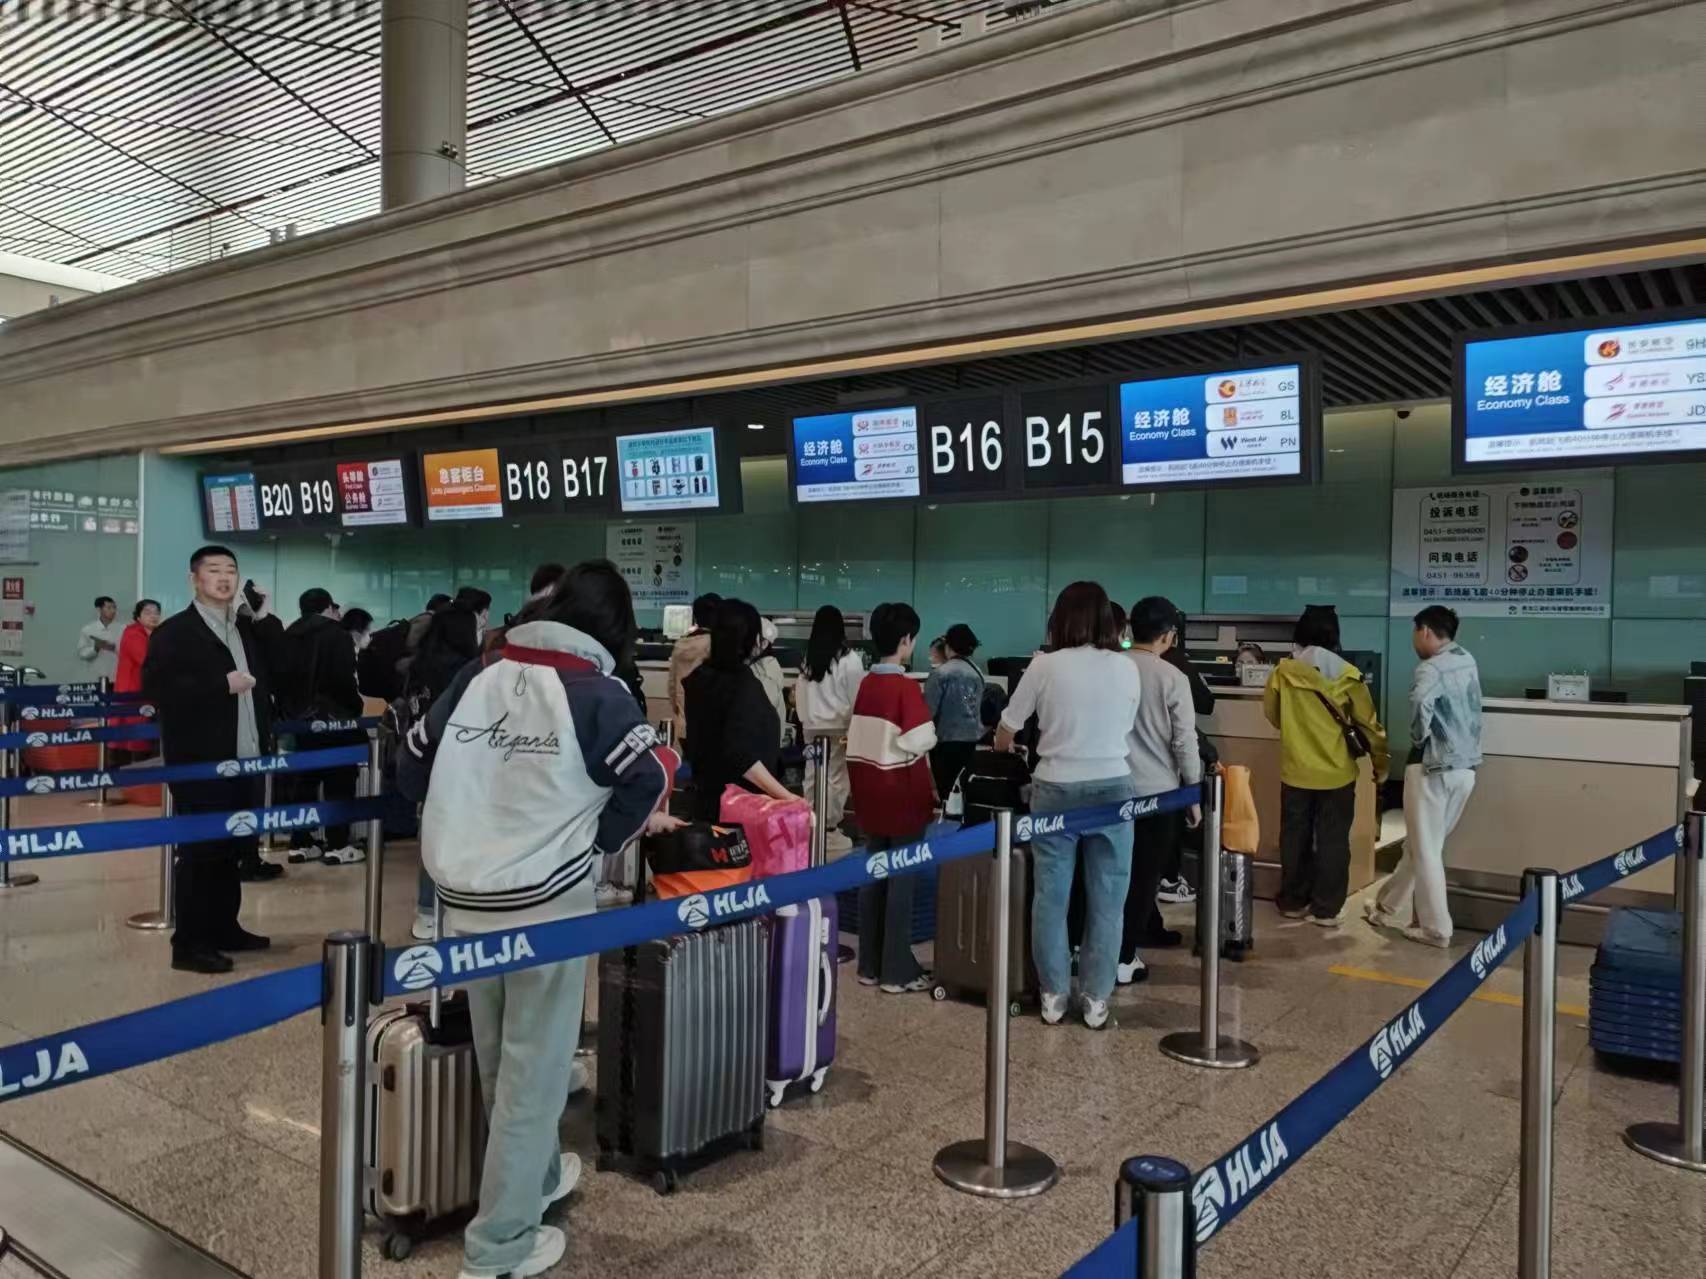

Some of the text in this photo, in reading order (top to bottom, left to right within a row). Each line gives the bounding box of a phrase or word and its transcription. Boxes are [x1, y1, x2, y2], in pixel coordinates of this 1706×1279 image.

[1278, 381, 1295, 392] GS
[1485, 370, 1562, 396] 经济舱
[1477, 394, 1570, 411] Economy Class
[1134, 408, 1190, 429] 经济舱
[1026, 411, 1104, 467] B15
[1129, 427, 1197, 441] Economy Class
[1281, 437, 1296, 448] PN
[803, 439, 843, 457] 经济舱
[931, 421, 1002, 474] B16
[800, 455, 848, 467] Economy Class
[507, 461, 550, 500] B18
[563, 456, 607, 497] B17
[261, 483, 293, 517] B20
[300, 480, 333, 514] B19
[1430, 505, 1479, 519] 投诉电话
[1428, 551, 1478, 563] 问询电话
[73, 694, 99, 704] HLJA
[41, 707, 74, 718] HLJA
[329, 719, 358, 730] HLJA
[52, 729, 92, 744] HLJA
[244, 756, 288, 773] HLJA
[60, 772, 114, 790] HLJA
[1134, 797, 1159, 815] HLJA
[263, 808, 320, 829] HLJA
[1035, 815, 1065, 834] HLJA
[8, 830, 84, 855] HLJA
[892, 843, 932, 870] HLJA
[1625, 846, 1646, 867] HLJA
[714, 884, 771, 916] HLJA
[450, 927, 536, 974] HLJA
[1388, 1003, 1426, 1056] HLJA
[1225, 1121, 1288, 1205] HLJA
